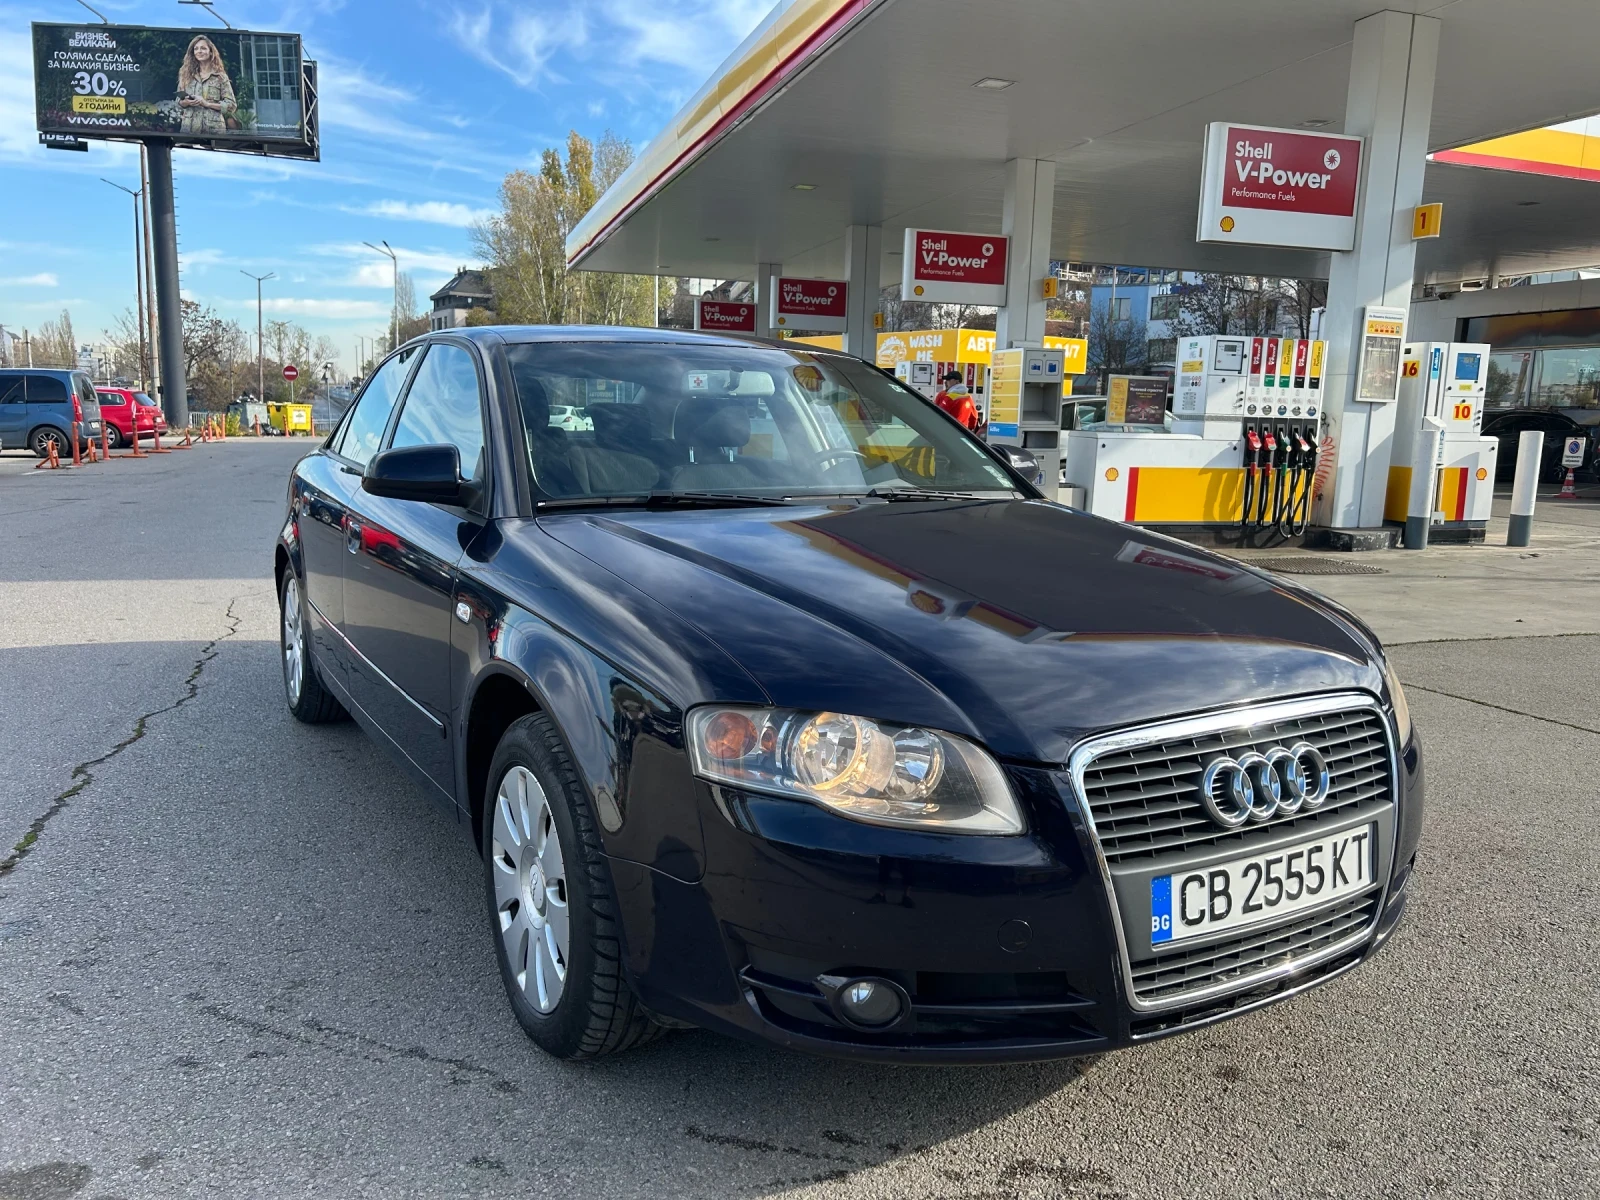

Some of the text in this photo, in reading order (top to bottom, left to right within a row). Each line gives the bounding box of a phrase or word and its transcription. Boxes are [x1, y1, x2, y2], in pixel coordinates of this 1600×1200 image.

[75, 32, 109, 40] БИЗНЕС
[69, 39, 116, 48] ВЕЛИКАНИ
[54, 51, 133, 62] ГОЛЯМА СДЕЛКА
[48, 60, 140, 71] ЗА МАЛКИЯ БИЗНЕС
[74, 71, 127, 96] 30%
[67, 117, 132, 126] VIVACOM
[1235, 141, 1273, 159] Shell
[1235, 160, 1331, 189] V-Power
[1231, 187, 1296, 201] Performance Fuels
[1419, 212, 1427, 230] 1
[922, 239, 947, 250] Shell
[922, 251, 988, 268] V-Power
[920, 268, 951, 276] Performance
[783, 284, 802, 292] Shell
[1045, 282, 1051, 294] 3
[783, 292, 833, 305] V-Power
[704, 312, 744, 322] V-Power
[875, 316, 880, 328] 5
[909, 334, 943, 348] WASH
[916, 350, 934, 362] ME
[1402, 363, 1418, 376] 16
[1454, 405, 1471, 419] 10
[1181, 832, 1368, 927] CB 2555 KT
[1151, 915, 1170, 933] BG
